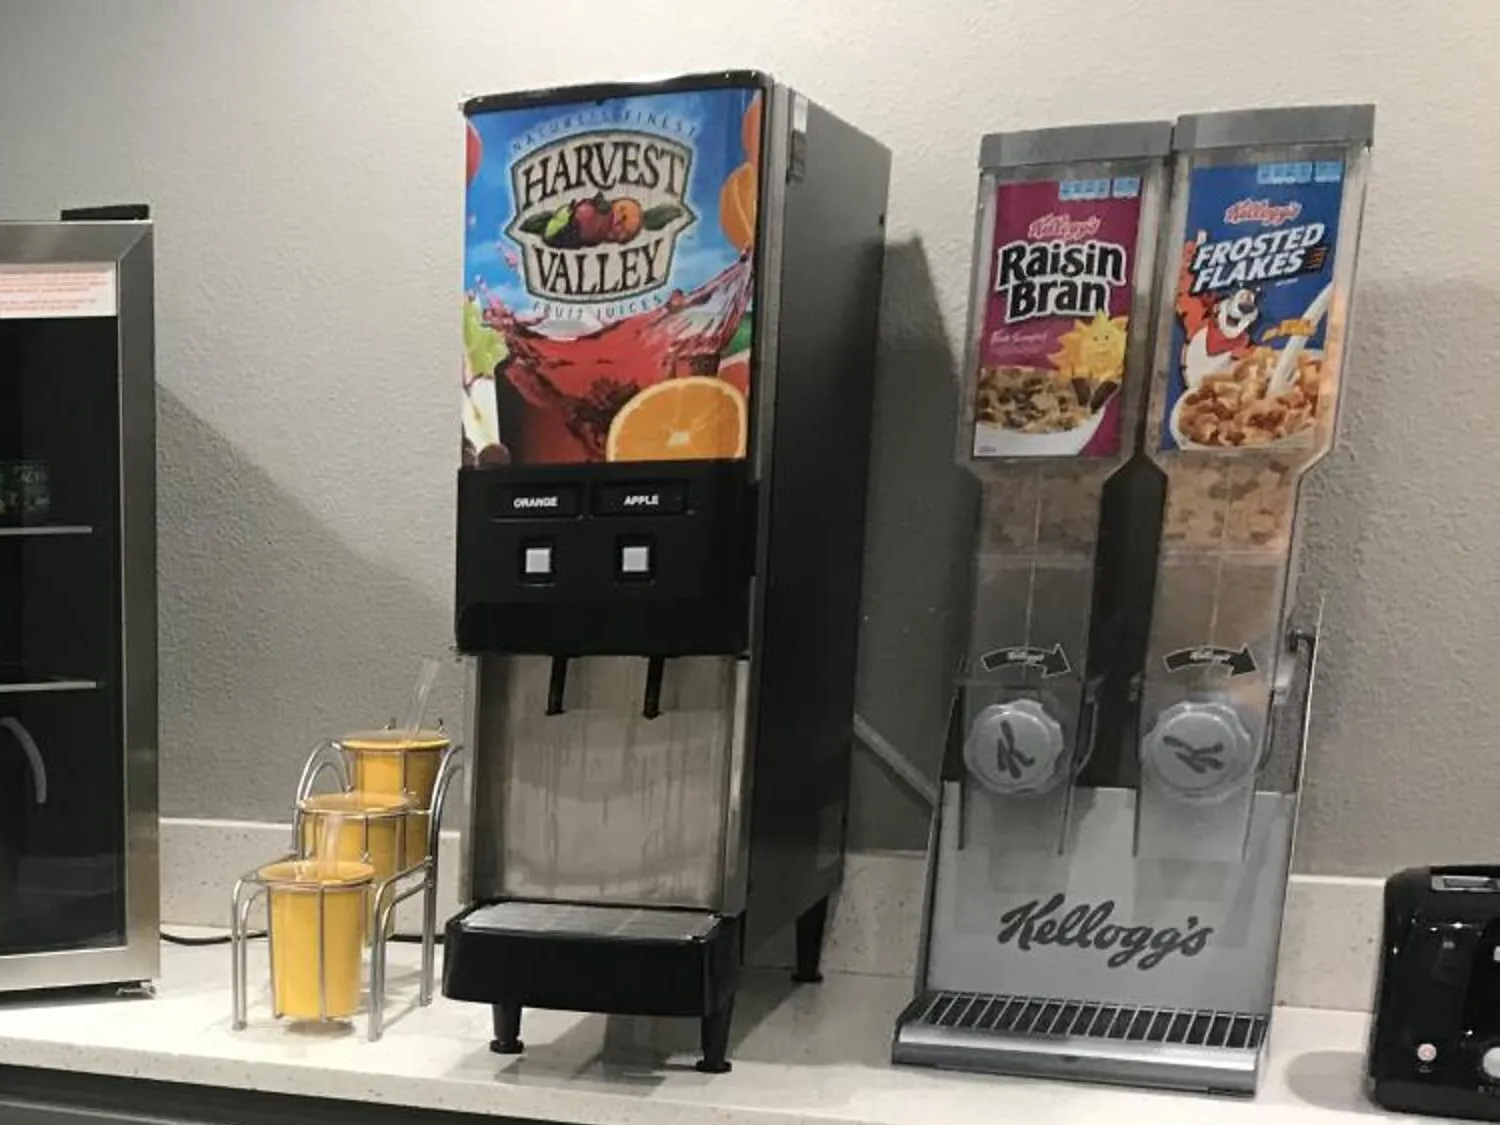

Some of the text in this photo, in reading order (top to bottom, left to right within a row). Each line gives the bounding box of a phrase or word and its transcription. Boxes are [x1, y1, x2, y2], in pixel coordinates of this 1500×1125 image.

[521, 141, 687, 211] HARVEST
[531, 239, 664, 295] VALLEY
[998, 241, 1124, 287] Raisin
[1192, 223, 1325, 270] FROSTED
[1192, 250, 1306, 293] FLAKES
[1008, 279, 1107, 320] Bran
[513, 494, 659, 508] ORANGE APPLE
[998, 893, 1213, 970] Kellogg's
